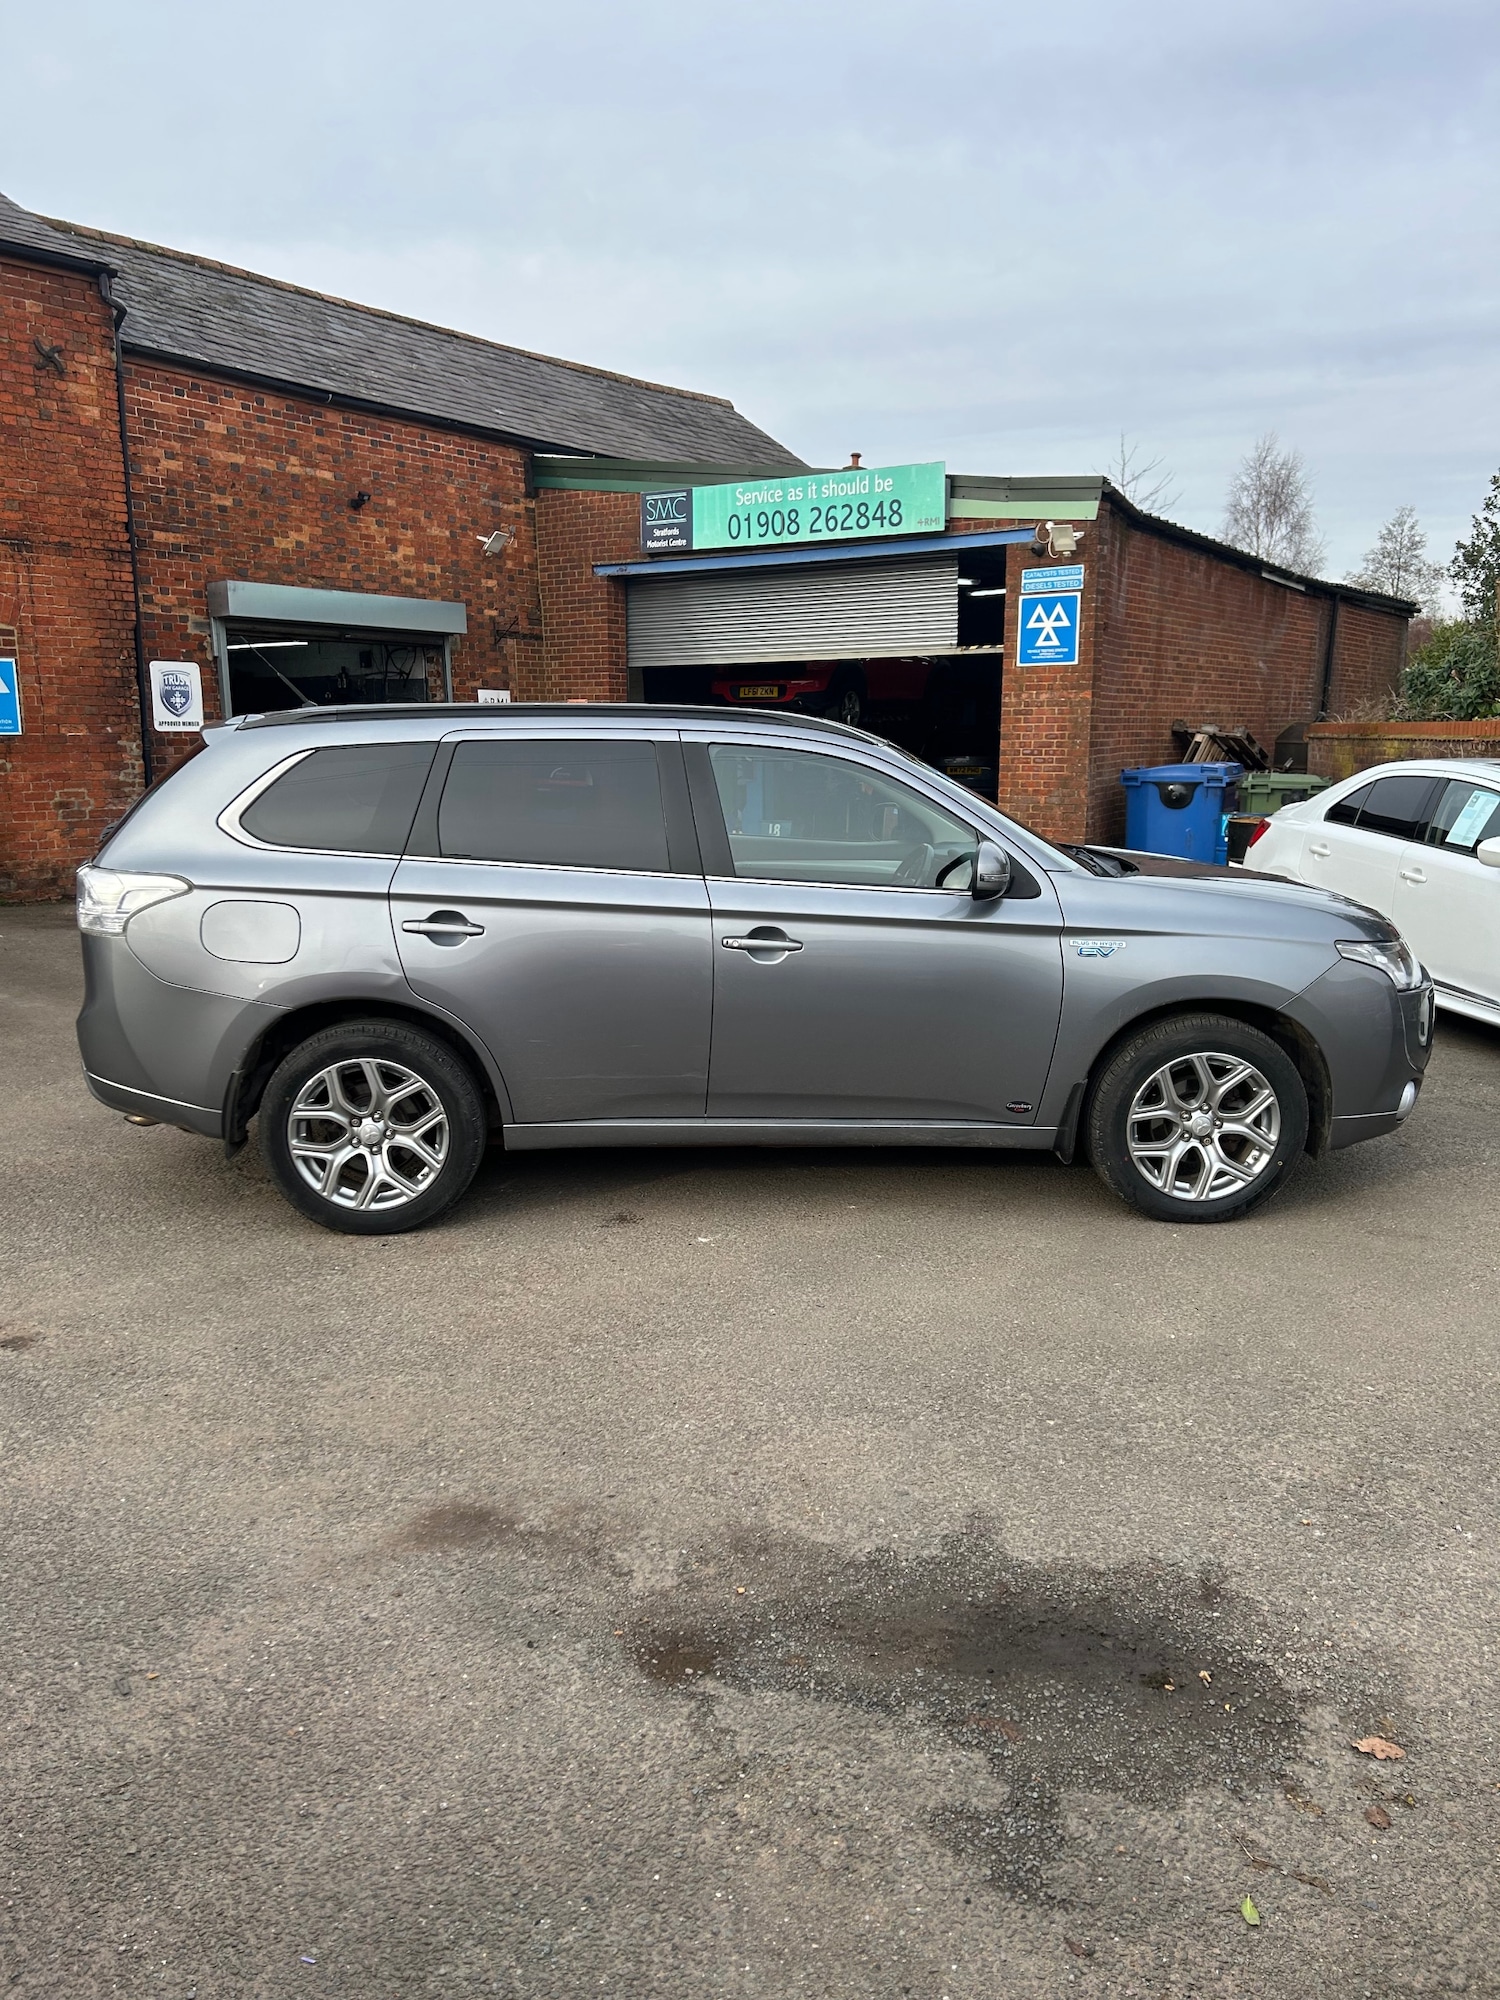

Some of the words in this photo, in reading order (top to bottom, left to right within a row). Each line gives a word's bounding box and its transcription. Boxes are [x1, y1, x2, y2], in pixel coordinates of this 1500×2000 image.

[735, 484, 783, 507] Service
[787, 486, 804, 501] as
[807, 480, 818, 499] it
[821, 475, 870, 498] should
[874, 475, 893, 493] be
[646, 497, 687, 521] SMC
[728, 508, 801, 540] 01908
[809, 499, 903, 534] 262848
[924, 517, 940, 527] RMI
[653, 527, 680, 537] Stratfords
[646, 539, 669, 548] Motorist
[669, 538, 687, 547] Centre
[1058, 568, 1080, 576] TESTED
[1025, 582, 1052, 590] DIESELS
[1054, 580, 1080, 588] TESTED
[1078, 947, 1117, 957] EV
